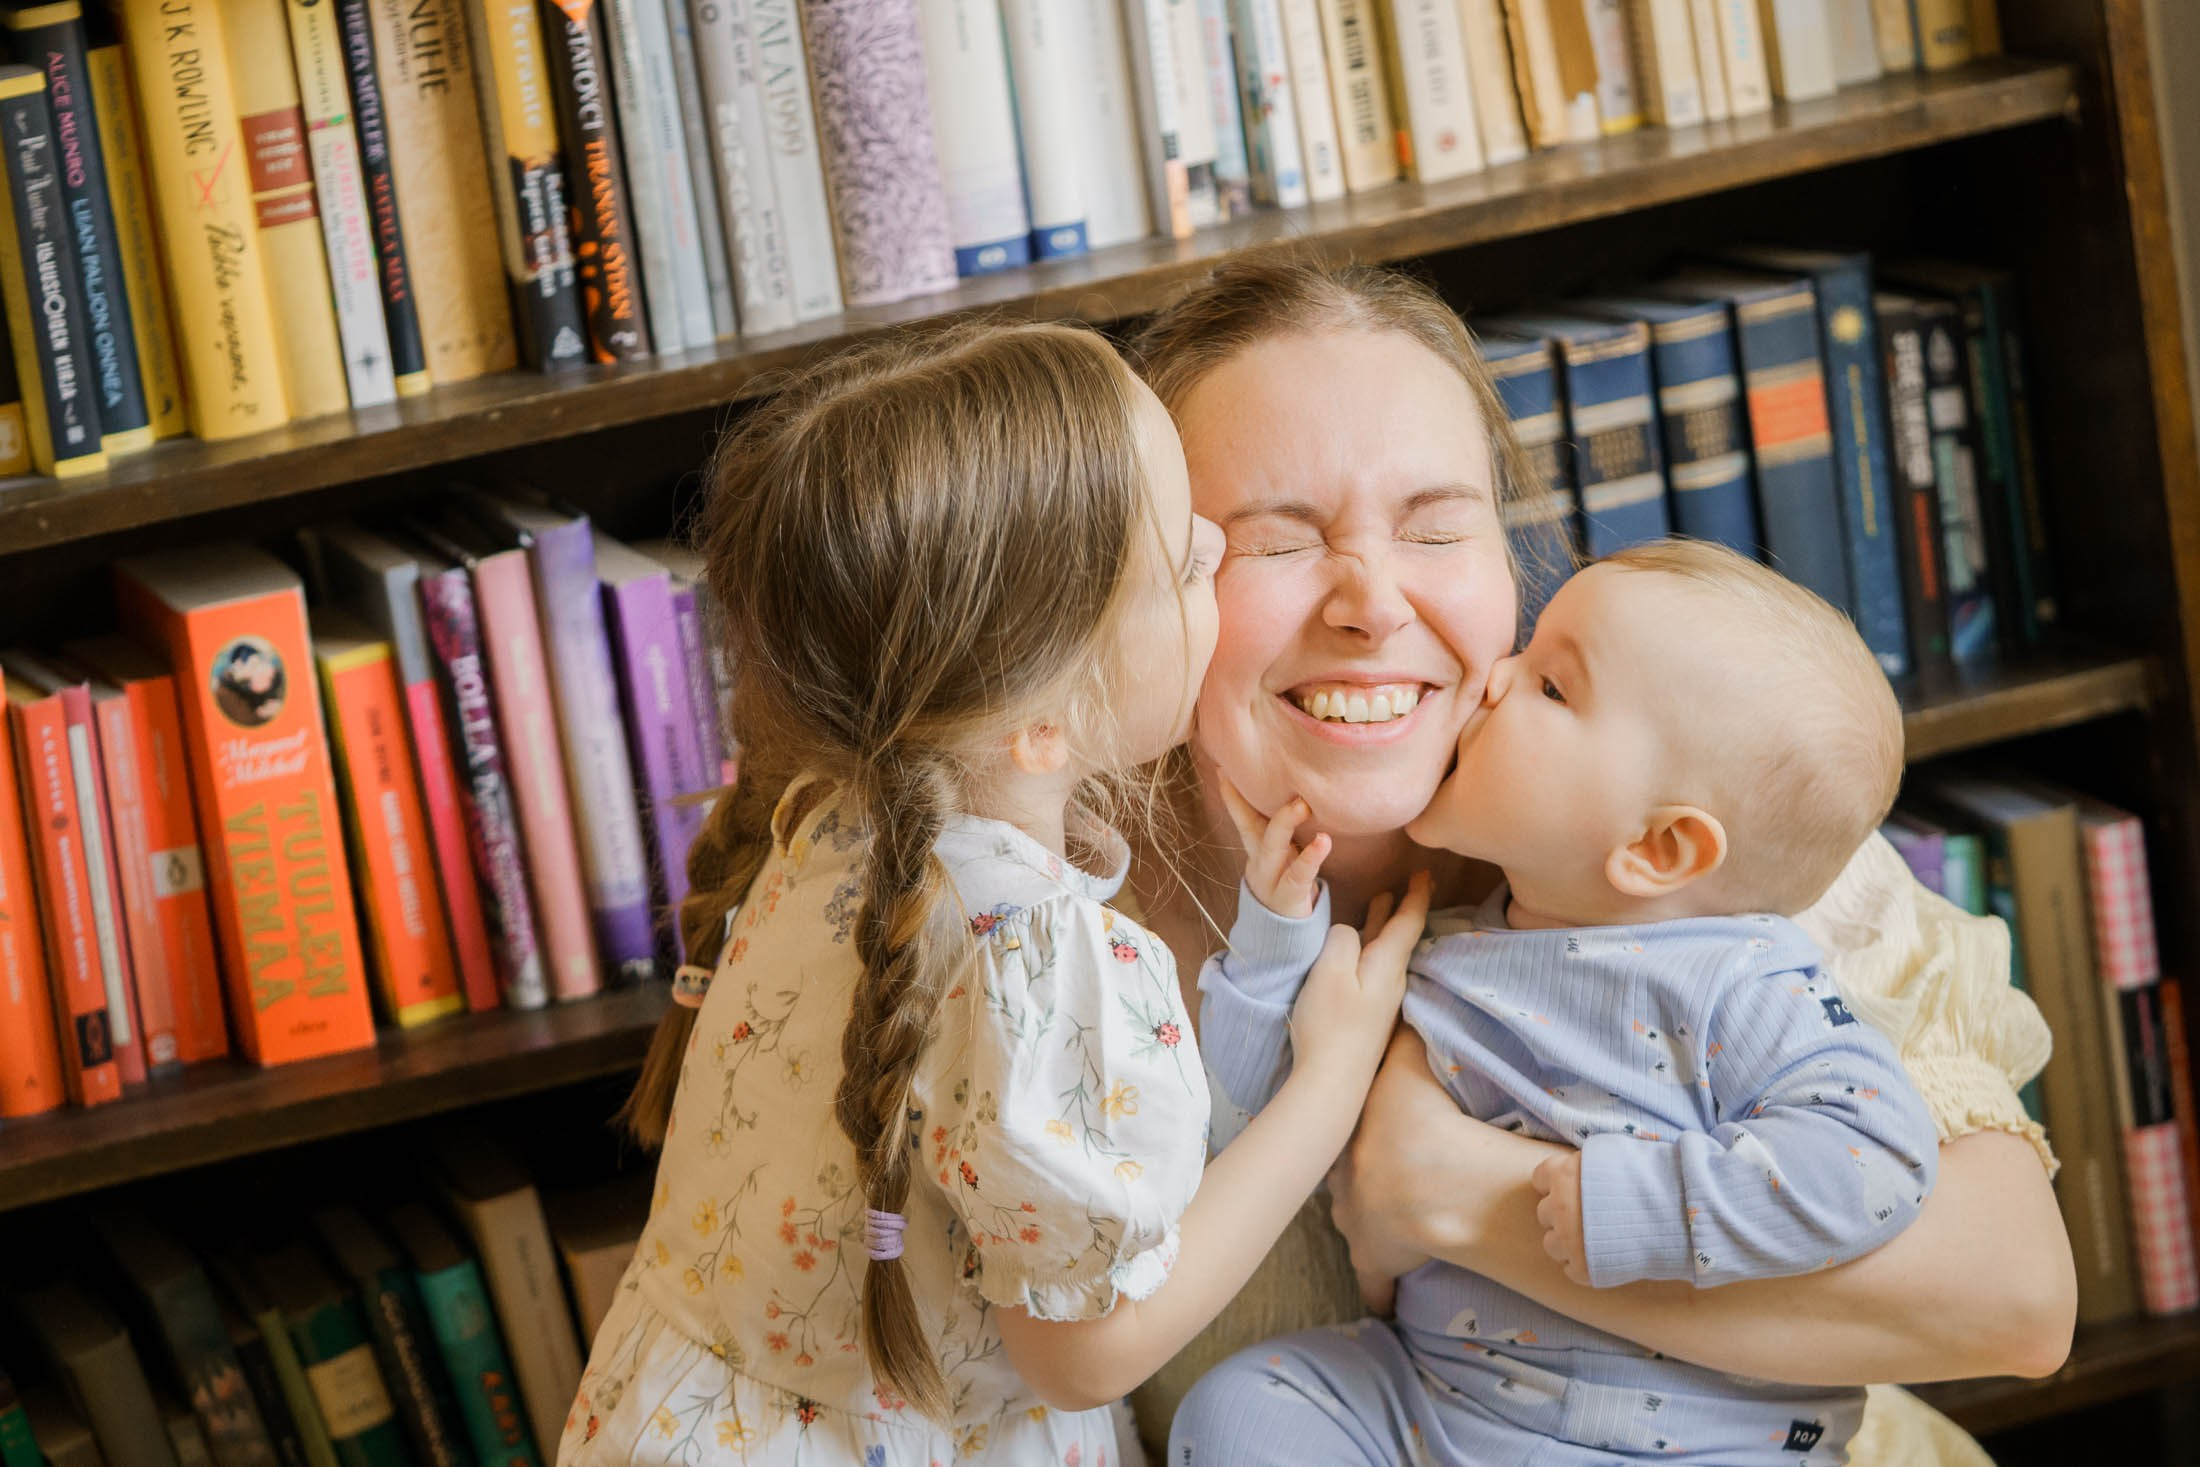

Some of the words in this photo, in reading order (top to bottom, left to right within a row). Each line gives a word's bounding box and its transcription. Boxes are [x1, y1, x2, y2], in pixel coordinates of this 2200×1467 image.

[46, 50, 73, 108] ALICE
[343, 2, 371, 72] HERTA
[507, 4, 543, 128] Ferrante
[564, 17, 605, 130] STATOVCI
[56, 111, 86, 188] MUNRO
[169, 48, 217, 157] ROWLING
[18, 133, 48, 174] Paul
[54, 354, 79, 401] KIRJA
[71, 198, 99, 254] LIIAN
[81, 254, 111, 333] PALJON
[95, 332, 124, 409] ONNEA
[450, 654, 497, 769] BOLLA
[225, 802, 296, 1015] VIEMAA
[278, 789, 350, 1000] TUULEN
[1793, 1430, 1817, 1444] POP
